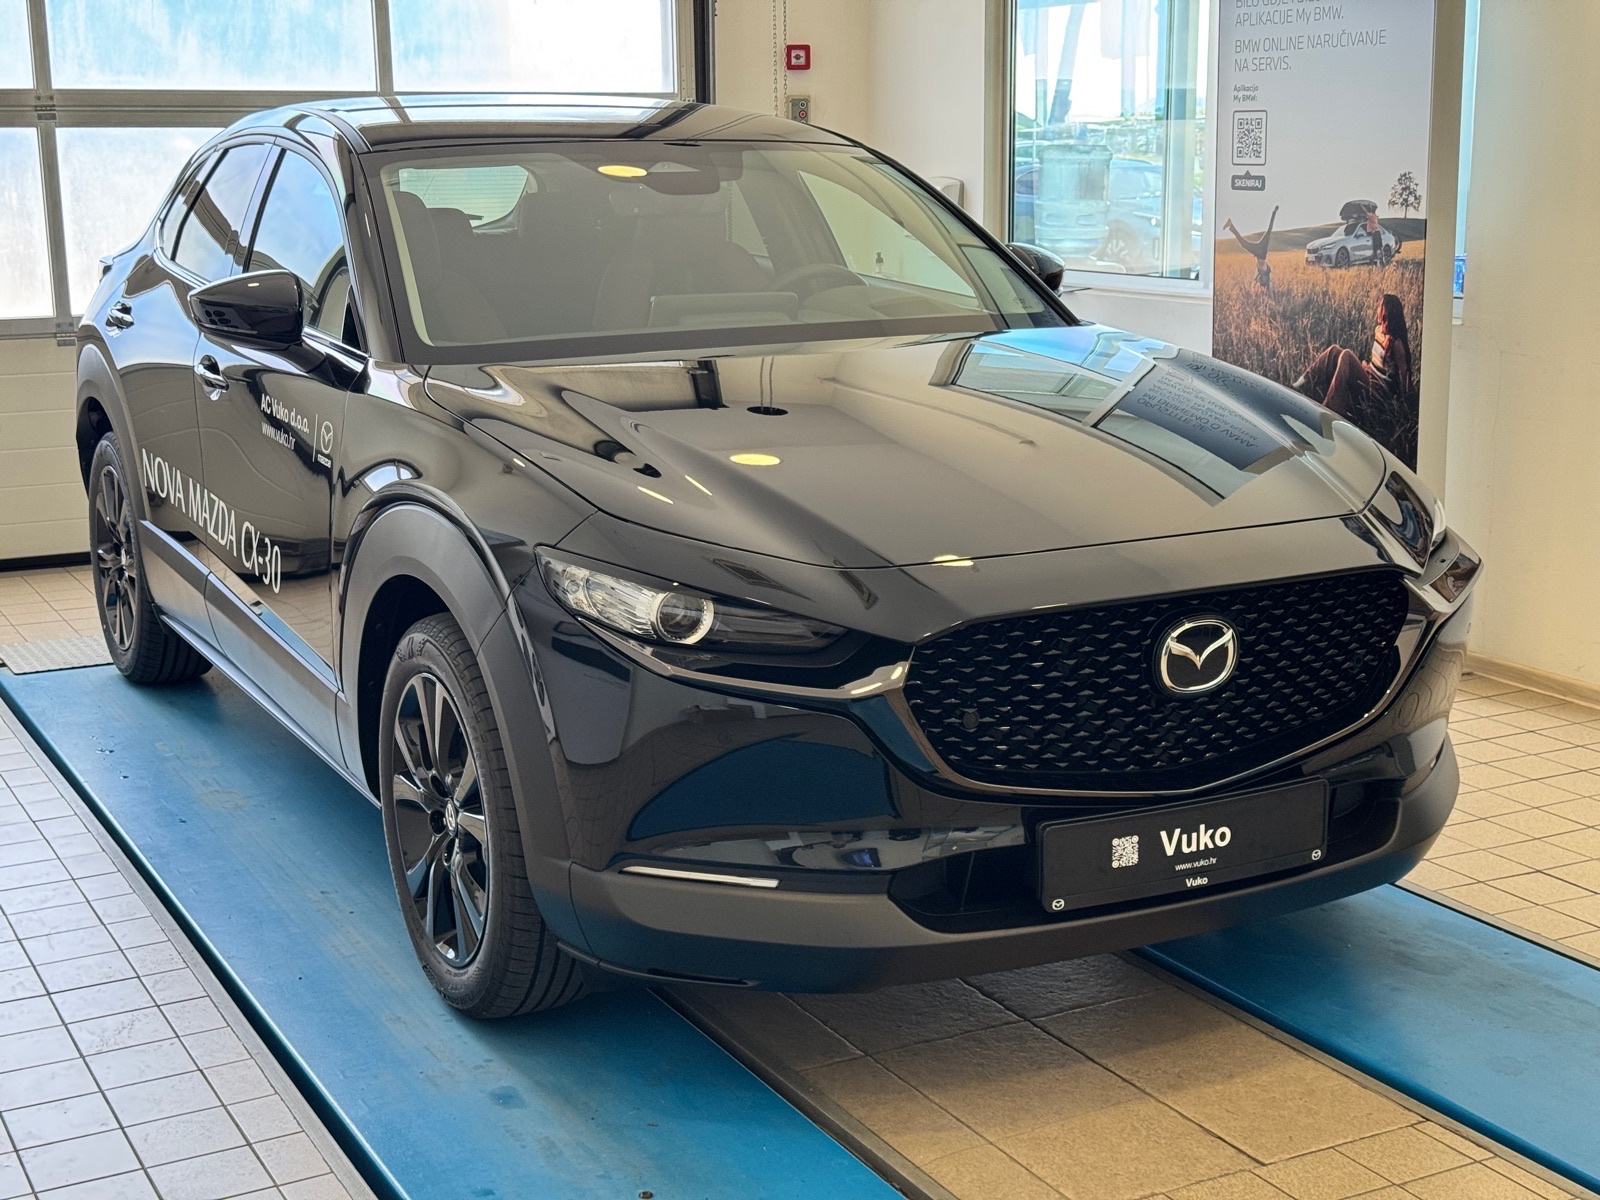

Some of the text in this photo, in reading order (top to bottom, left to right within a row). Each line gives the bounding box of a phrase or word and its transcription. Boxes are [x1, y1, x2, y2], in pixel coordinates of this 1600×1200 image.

[1235, 5, 1344, 27] APLIKACIJE My BMW.
[1235, 29, 1387, 54] BMW ONLINE NARUČIVANJE
[1234, 56, 1292, 73] NA SERVIS.
[261, 393, 310, 434] AC Vuko d.o.o.
[262, 422, 296, 450] www.vuko.hr
[142, 448, 281, 594] NOVA MAZDA CX-30
[1160, 824, 1232, 856] Vuko
[1174, 856, 1217, 871] www.vuko.hr
[1185, 876, 1208, 888] Vuko
